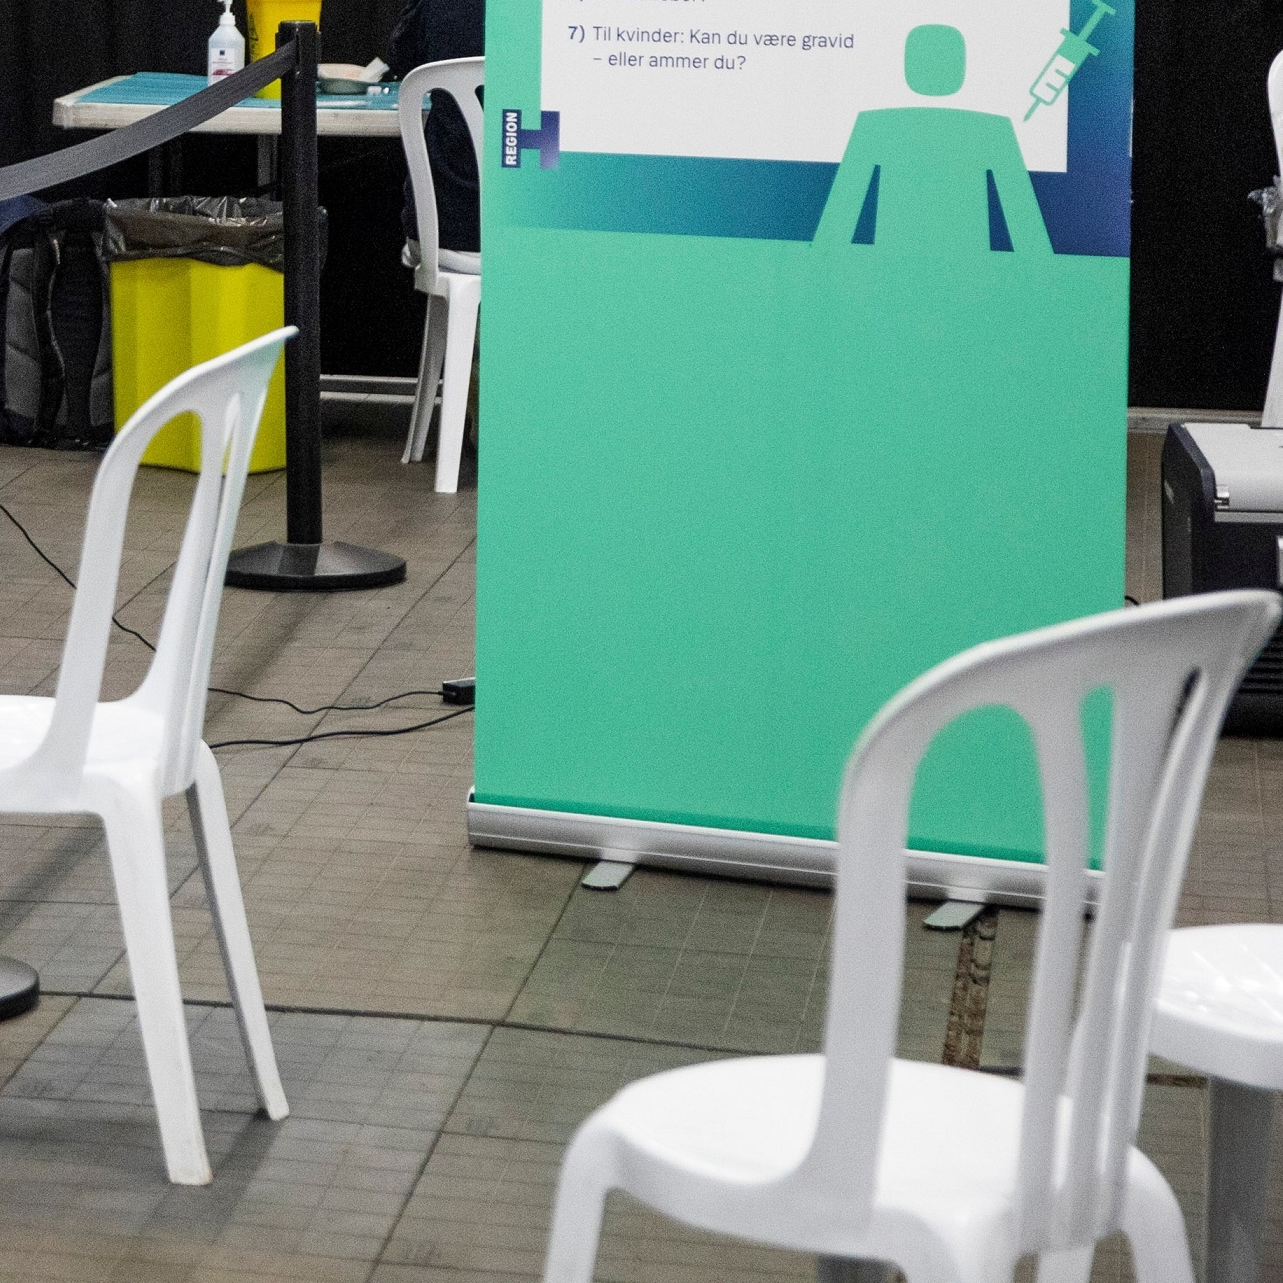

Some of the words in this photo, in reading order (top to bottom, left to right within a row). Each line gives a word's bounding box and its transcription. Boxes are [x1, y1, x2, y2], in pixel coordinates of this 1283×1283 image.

[567, 24, 586, 44] 7)
[592, 25, 612, 41] Til
[616, 26, 684, 44] kvinder:
[689, 29, 722, 45] Kan
[726, 29, 748, 46] du
[752, 33, 797, 47] være
[801, 33, 854, 51] gravid
[607, 51, 645, 67] eller
[648, 55, 710, 69] ammer
[713, 54, 747, 71] du?
[505, 111, 519, 166] REGION
